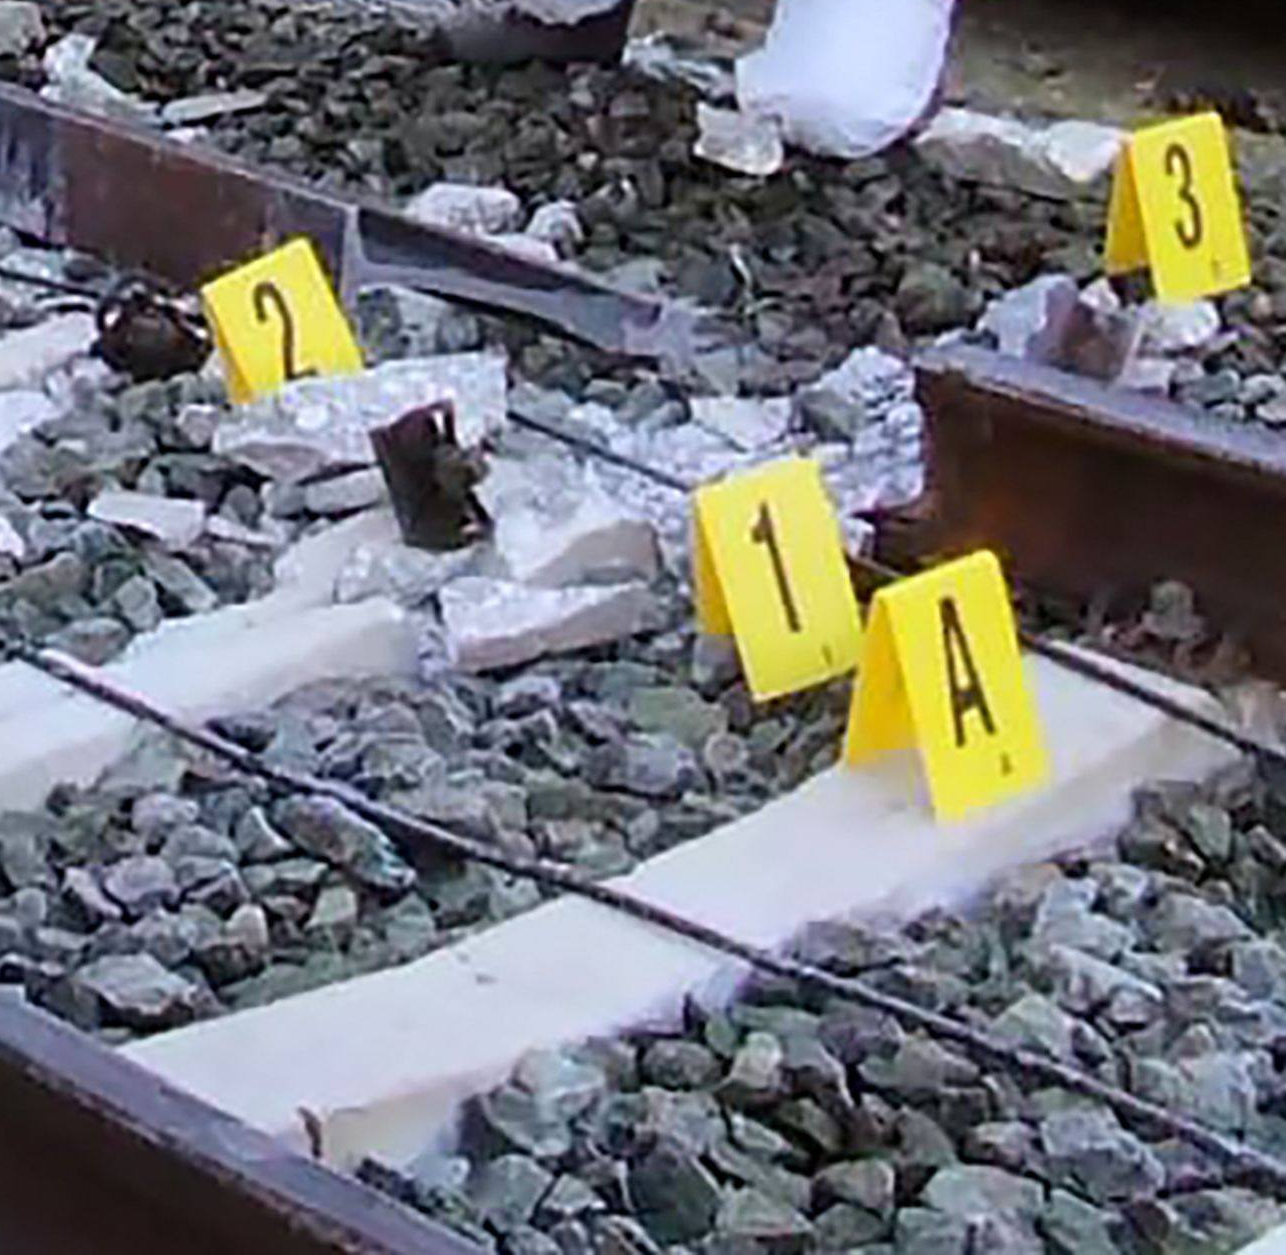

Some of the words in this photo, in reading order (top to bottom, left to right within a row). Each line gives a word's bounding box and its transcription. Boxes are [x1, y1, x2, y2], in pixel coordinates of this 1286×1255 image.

[1165, 142, 1203, 251] 3
[253, 280, 319, 380] 2
[750, 501, 802, 633] 1
[938, 596, 997, 748] A
